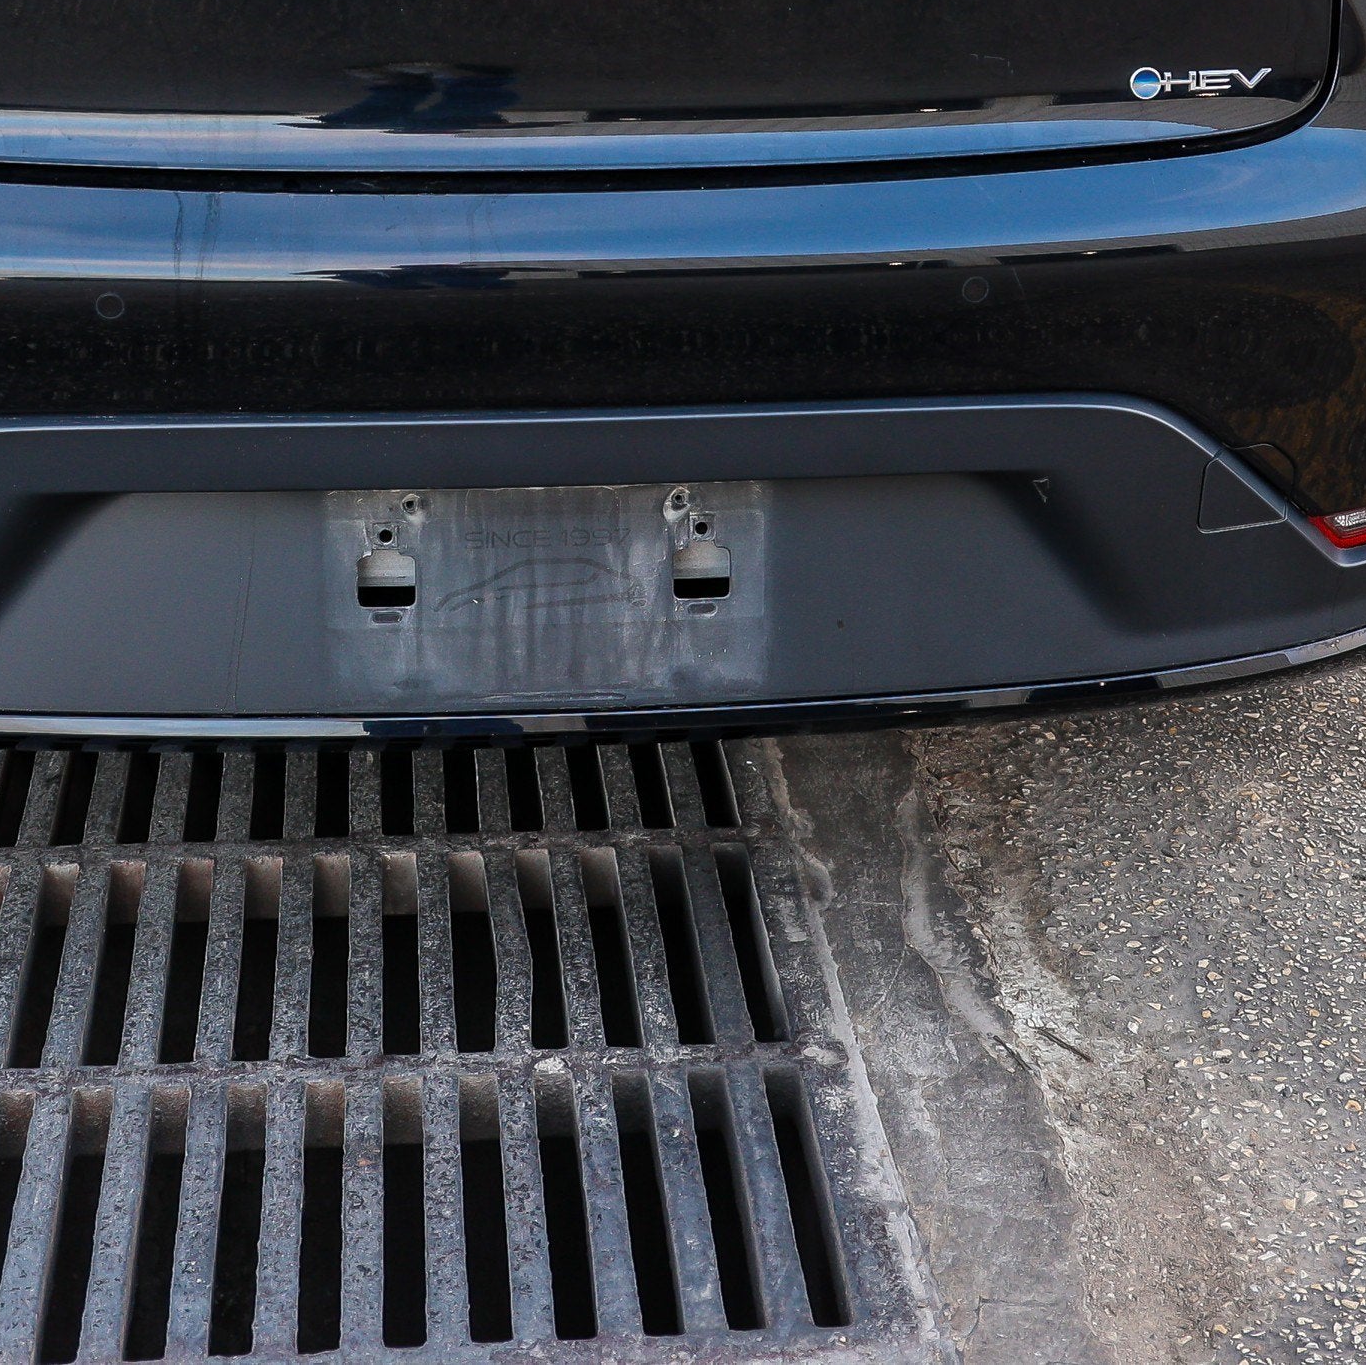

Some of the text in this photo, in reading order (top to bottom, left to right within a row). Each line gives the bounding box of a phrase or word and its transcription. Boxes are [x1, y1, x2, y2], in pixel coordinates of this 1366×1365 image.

[1163, 67, 1273, 92] HEV
[464, 526, 632, 549] SINCE 1997
